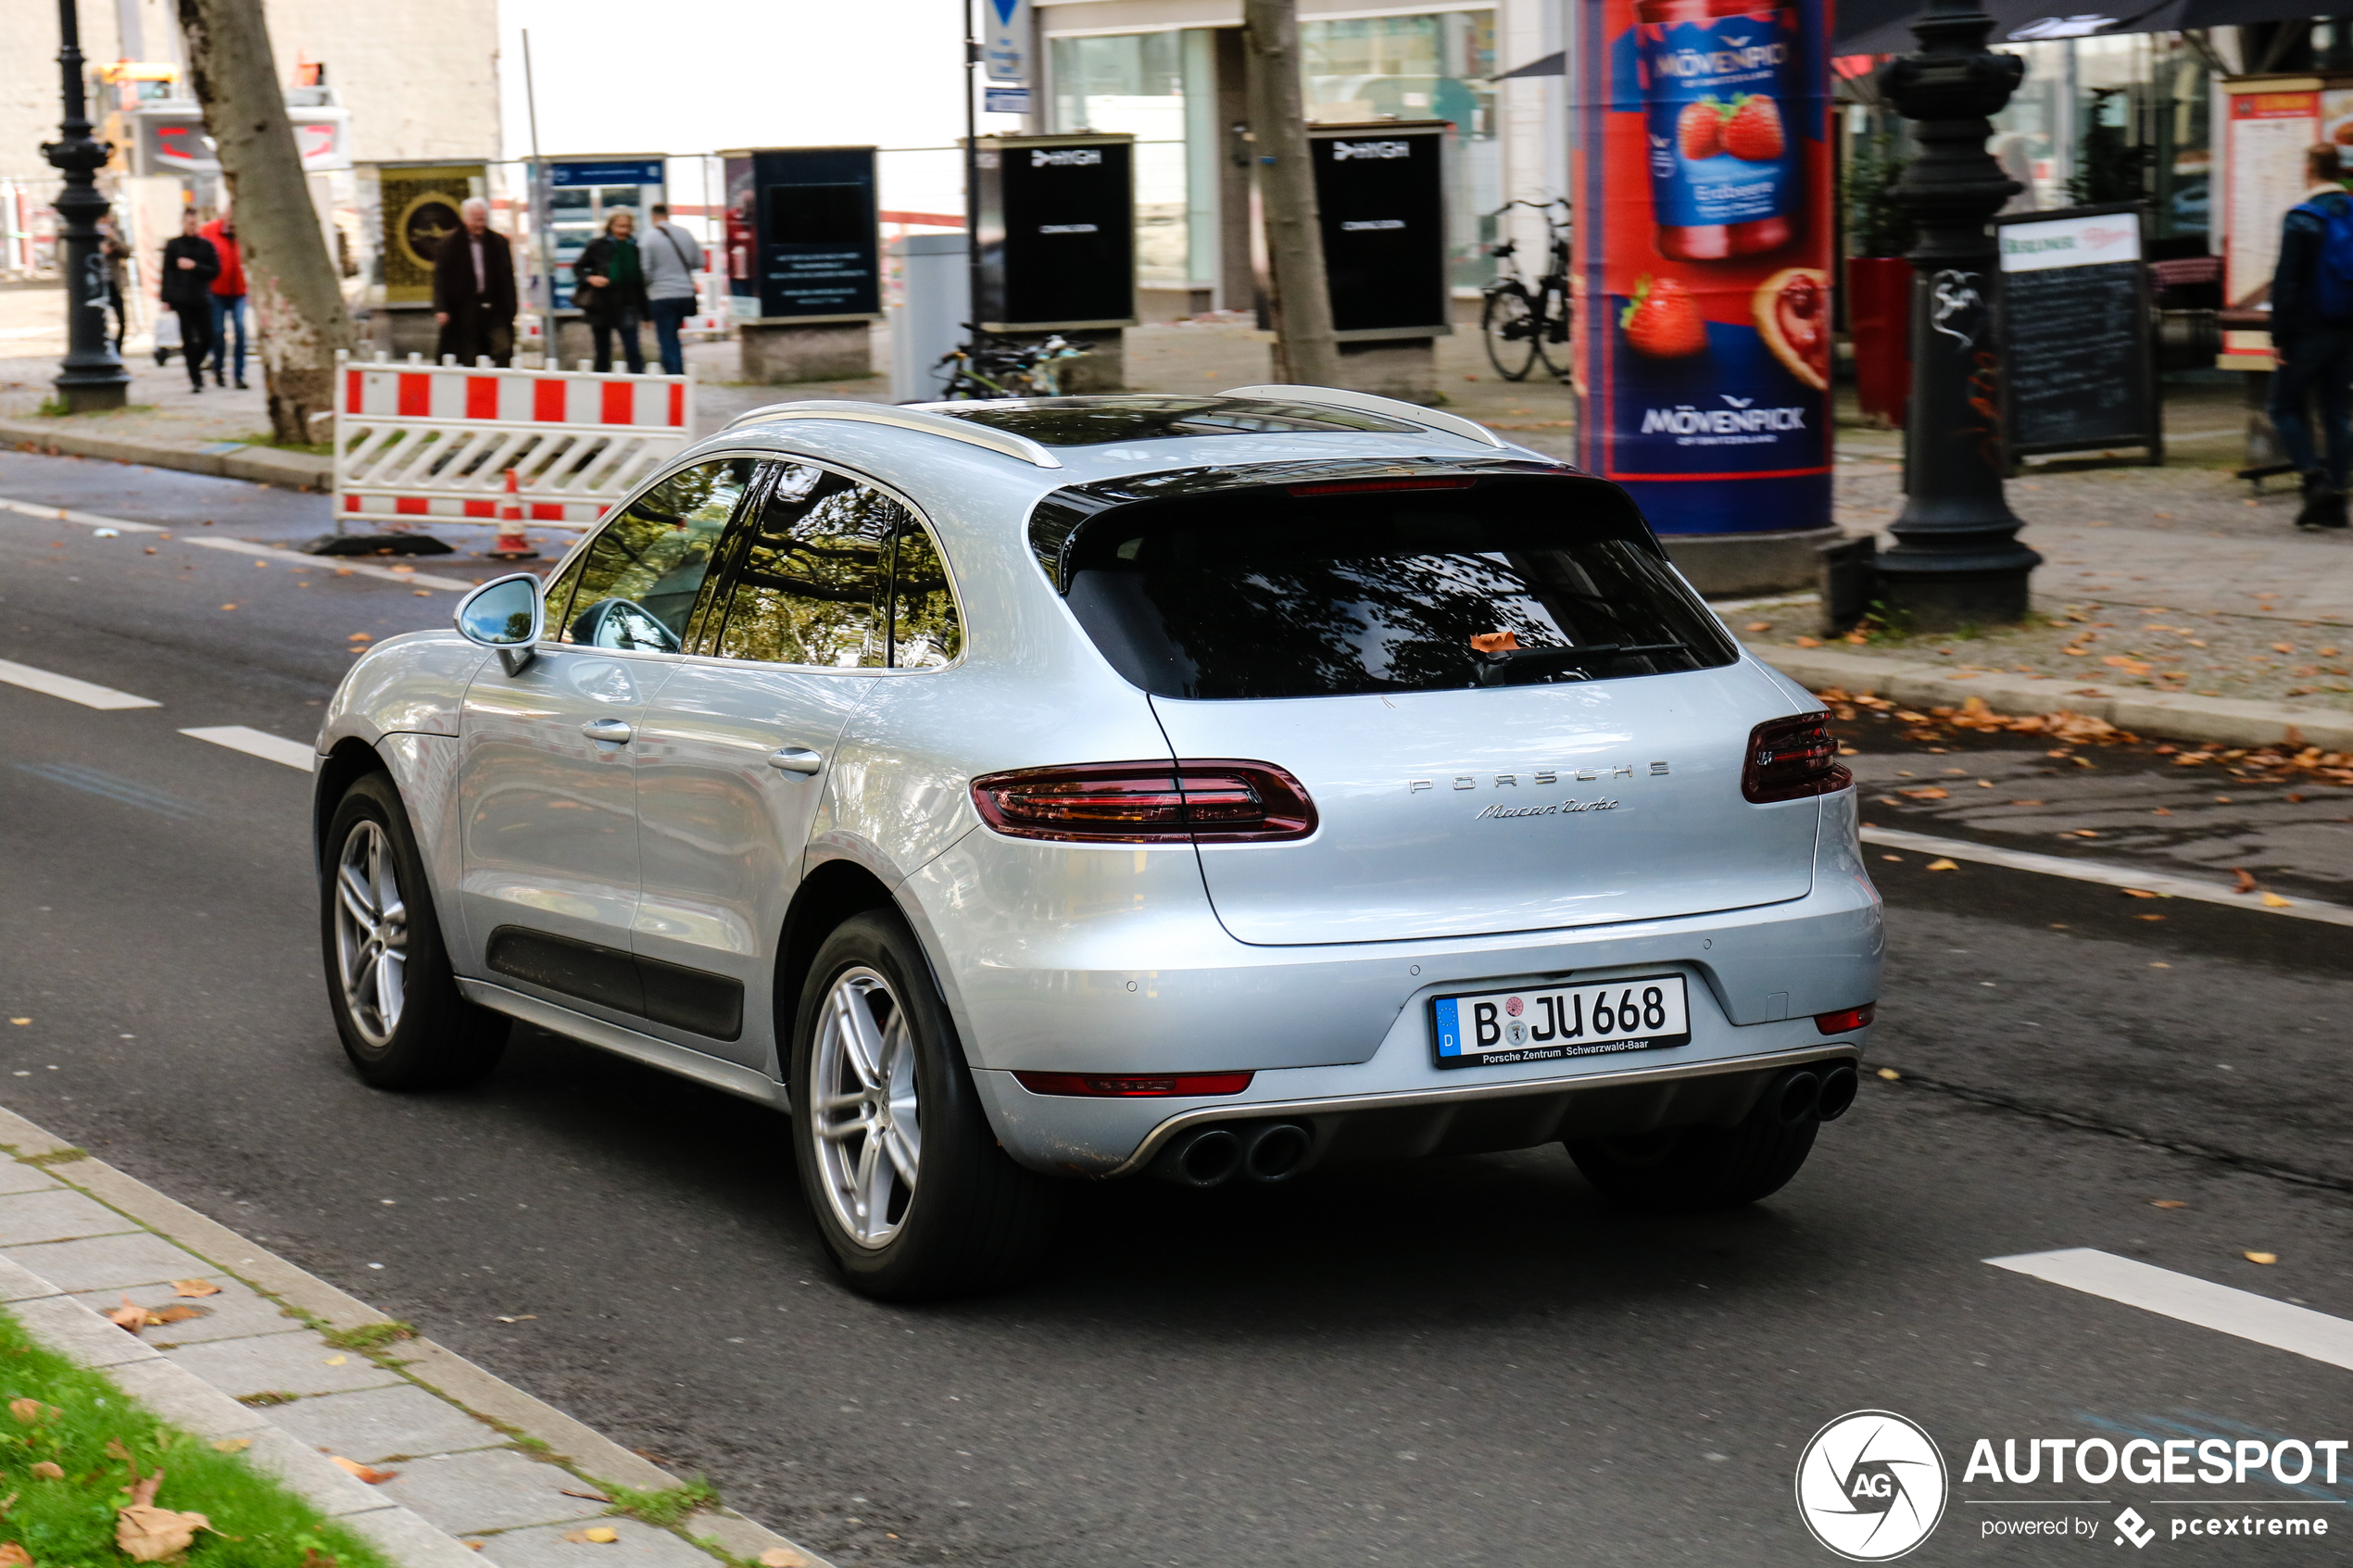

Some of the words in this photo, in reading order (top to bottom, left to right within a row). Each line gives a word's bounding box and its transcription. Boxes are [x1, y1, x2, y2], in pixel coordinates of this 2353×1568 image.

[1640, 404, 1807, 435] MÖVENPICK
[1408, 759, 1670, 795] PORSCHE
[1475, 803, 1557, 822] Macan
[1474, 1001, 1502, 1047] B
[1530, 993, 1584, 1042] JU
[1592, 985, 1666, 1035] 668
[1443, 1034, 1453, 1047] D
[1482, 1051, 1521, 1064] Porsche
[1522, 1047, 1562, 1060] Zentrum
[1566, 1039, 1649, 1056] Schwarzwald-Baar
